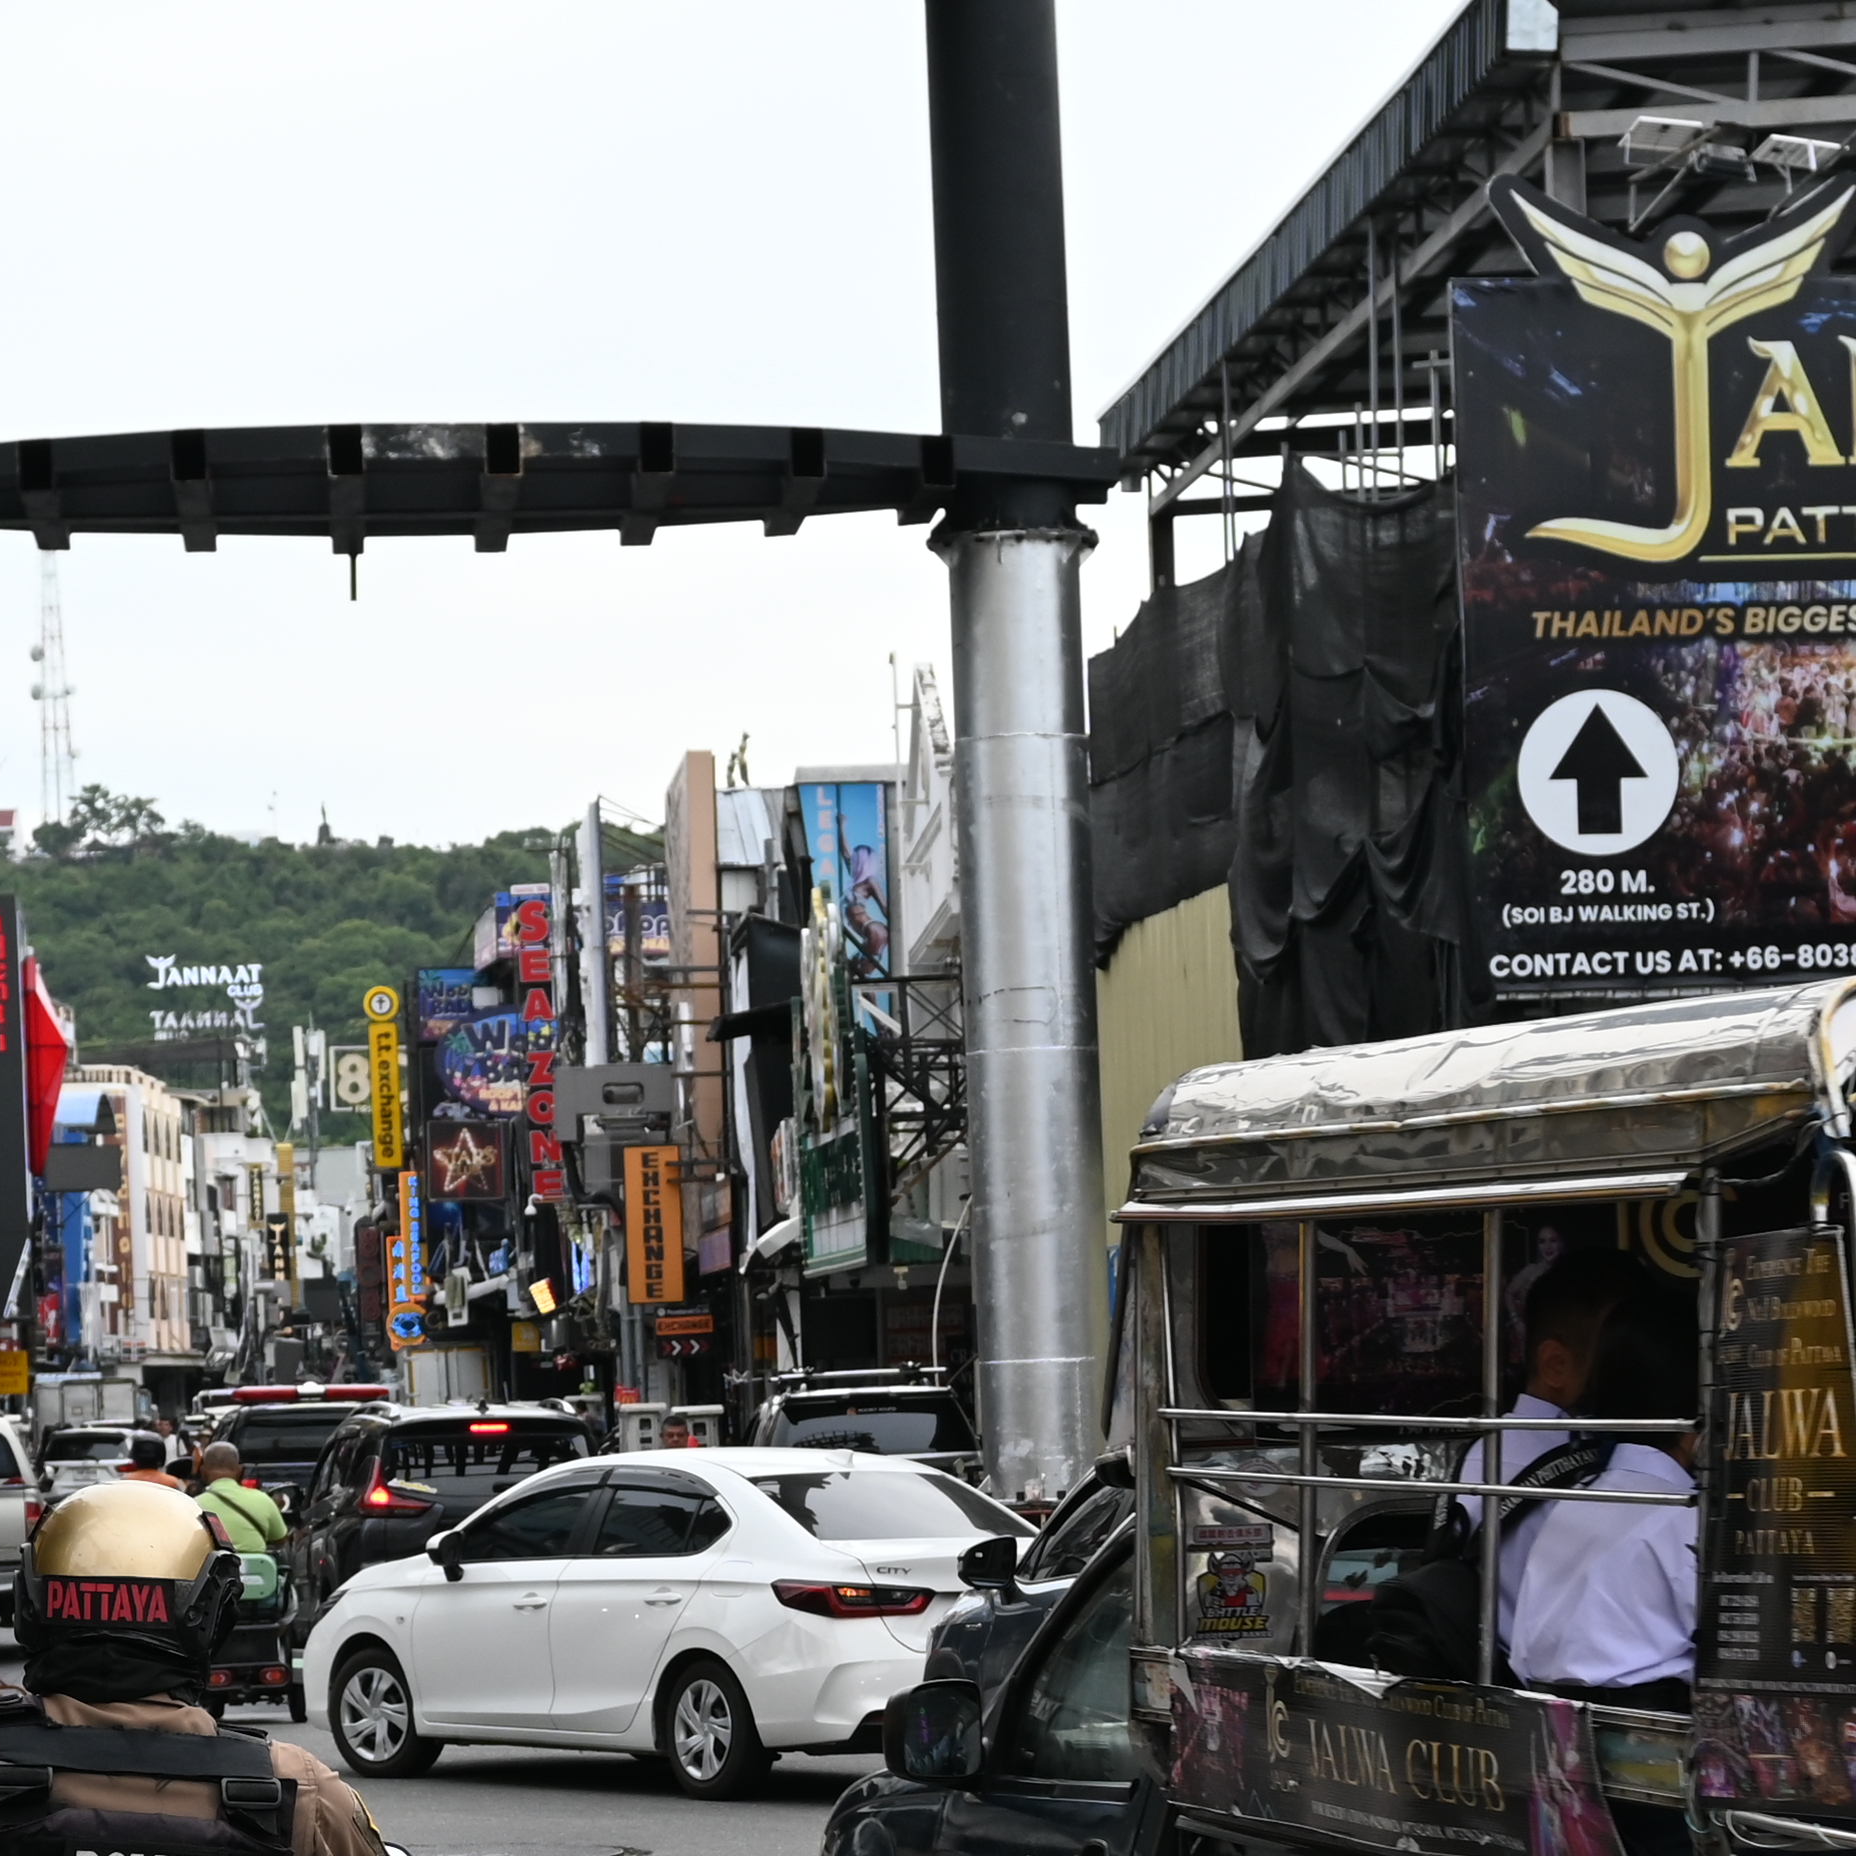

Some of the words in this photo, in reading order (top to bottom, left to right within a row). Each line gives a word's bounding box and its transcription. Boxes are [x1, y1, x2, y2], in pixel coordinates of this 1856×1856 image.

[1533, 605, 1734, 639] THAILAND'S
[816, 786, 836, 876] LEGA
[1560, 870, 1616, 894] 280
[1621, 870, 1656, 894] M.
[1501, 903, 1545, 929] (SOI
[1548, 903, 1574, 924] BJ
[1578, 901, 1673, 923] WALKING
[1676, 898, 1716, 924] ST.)
[145, 952, 264, 990] JANNAAT
[518, 900, 555, 1022] SEA
[1489, 950, 1628, 980] CONTACT
[1634, 950, 1672, 976] US
[1675, 949, 1723, 973] AT:
[227, 984, 264, 998] CLUB
[1724, 1386, 1849, 1461] JALWA
[1746, 1478, 1804, 1512] CLUB
[1735, 1529, 1816, 1555] PATTAYA
[876, 1566, 912, 1575] CITY
[46, 1581, 169, 1624] PATTAYA
[1207, 1606, 1259, 1617] BATTLE
[1200, 1617, 1267, 1631] MOUSE
[1307, 1717, 1399, 1796] JALWA
[1404, 1738, 1506, 1813] CLUB
